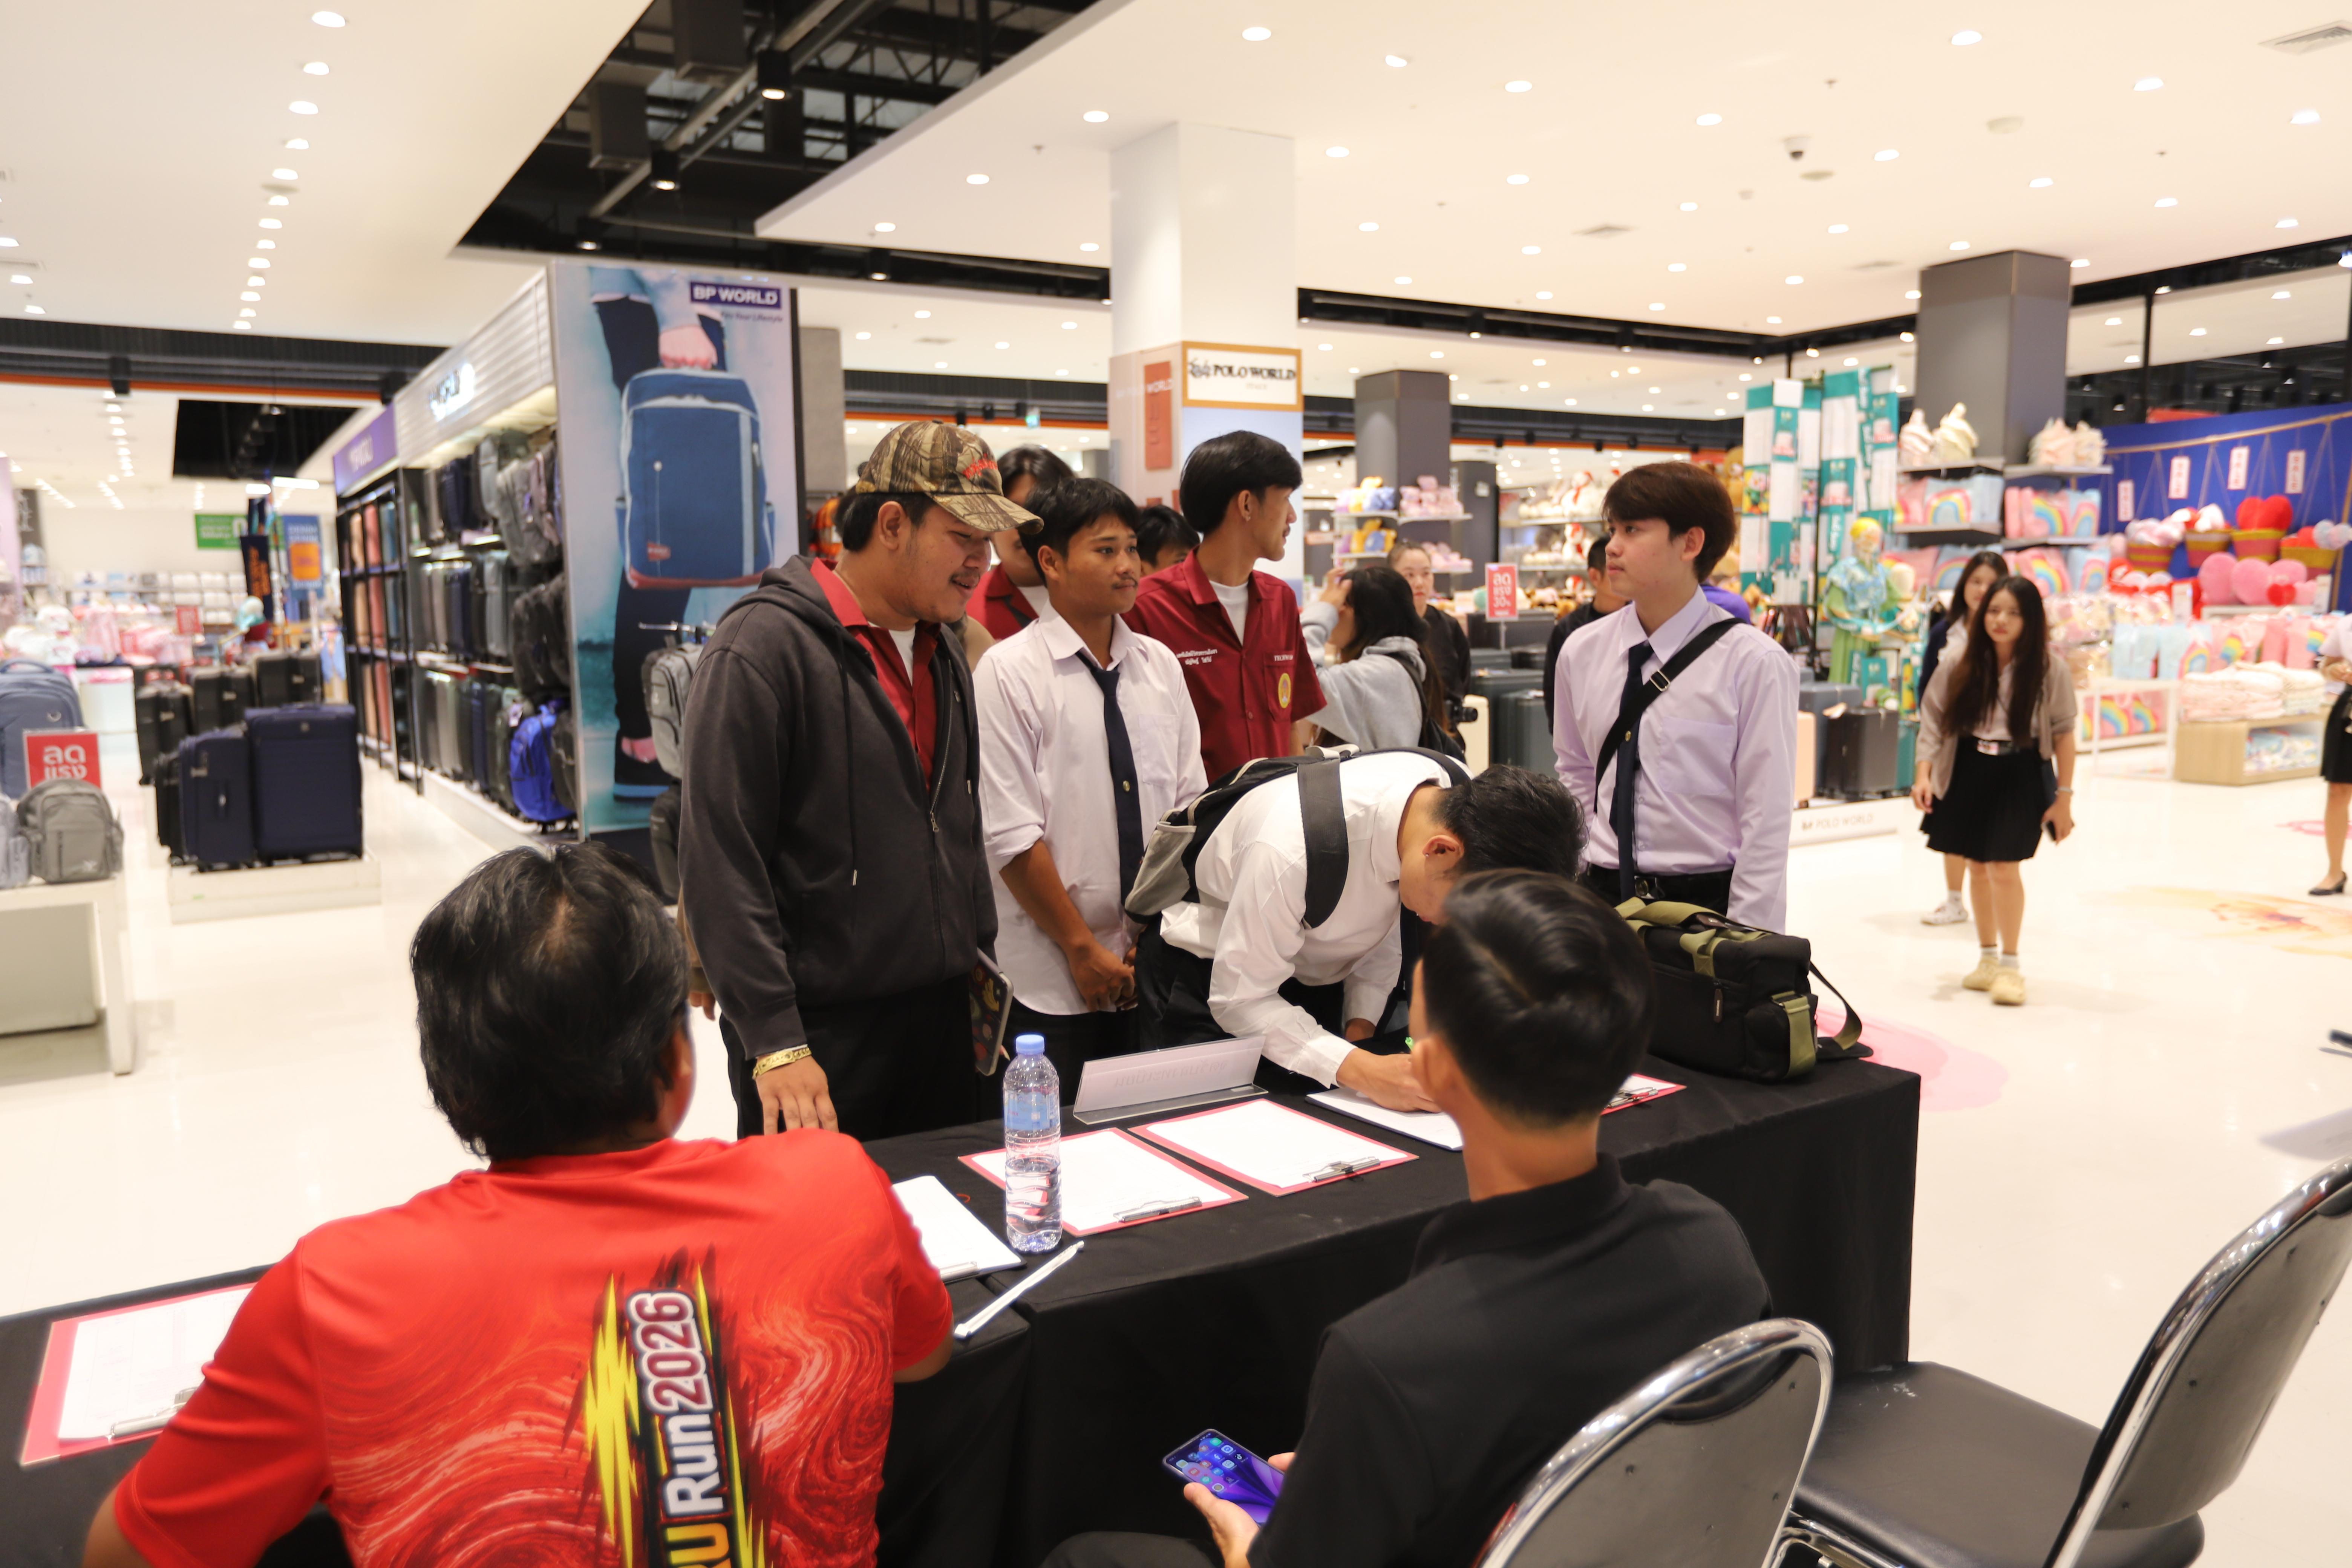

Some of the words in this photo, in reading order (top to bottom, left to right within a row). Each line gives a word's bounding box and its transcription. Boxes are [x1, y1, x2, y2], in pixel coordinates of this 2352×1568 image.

[693, 285, 716, 300] BP
[718, 287, 778, 305] WORLD
[1213, 364, 1247, 378] POLO
[1249, 366, 1297, 380] WORLD
[43, 744, 87, 765] ลด
[44, 765, 88, 779] แรง
[666, 1524, 732, 1568] U
